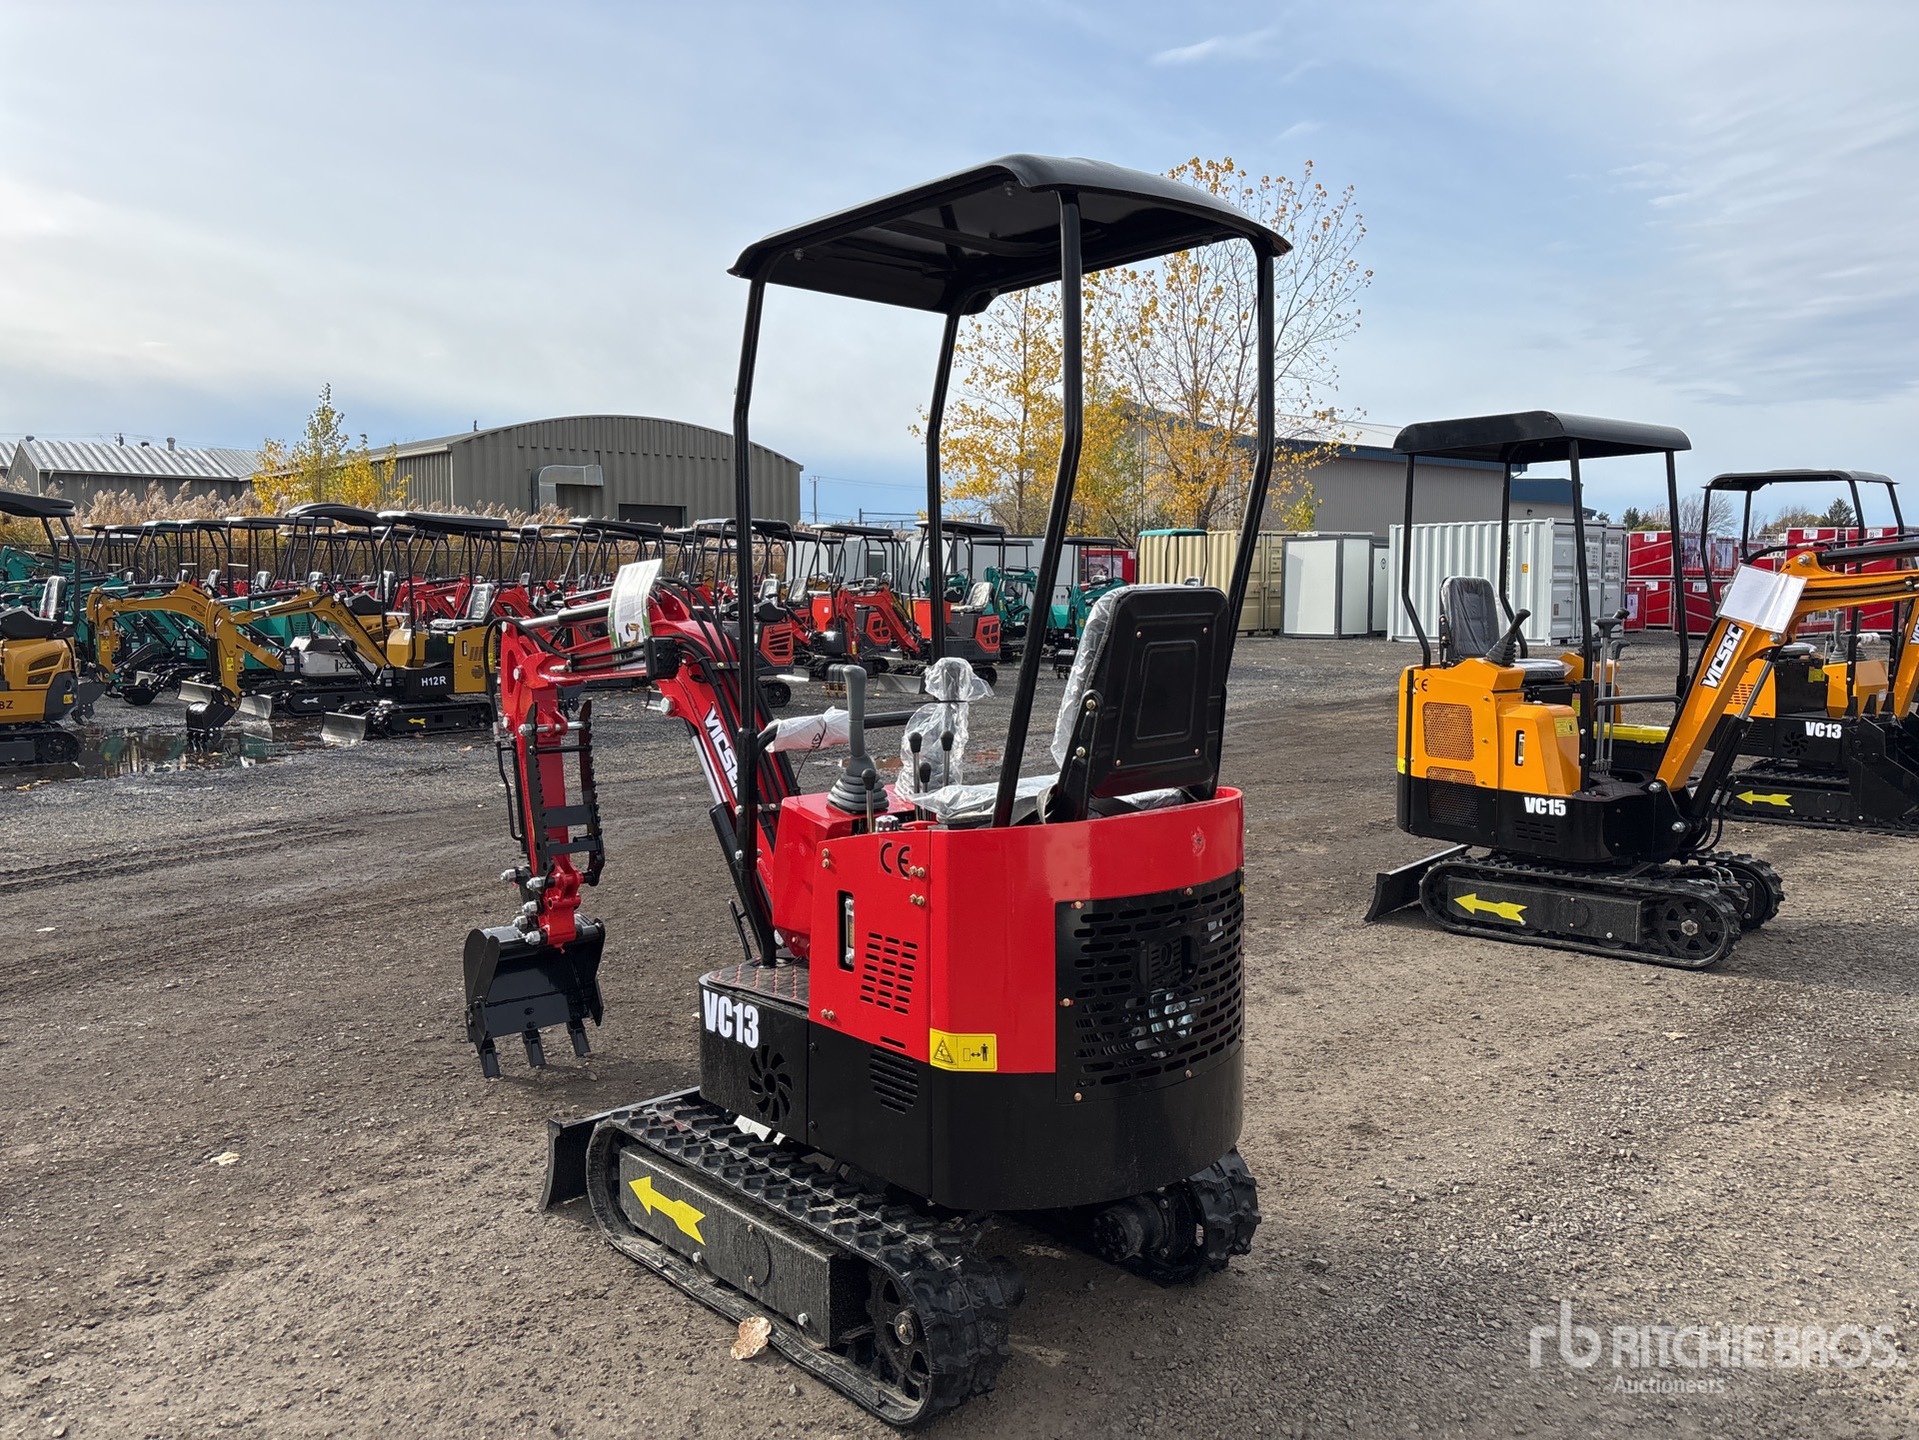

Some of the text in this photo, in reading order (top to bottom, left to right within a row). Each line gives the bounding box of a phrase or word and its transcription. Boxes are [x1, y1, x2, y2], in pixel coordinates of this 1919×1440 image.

[1702, 622, 1744, 688] VICSEC
[421, 675, 447, 688] H12R
[1805, 721, 1842, 739] VC13
[704, 706, 738, 800] VICSE
[1524, 796, 1567, 817] VC15
[880, 842, 910, 879] CE
[702, 988, 760, 1049] VC13
